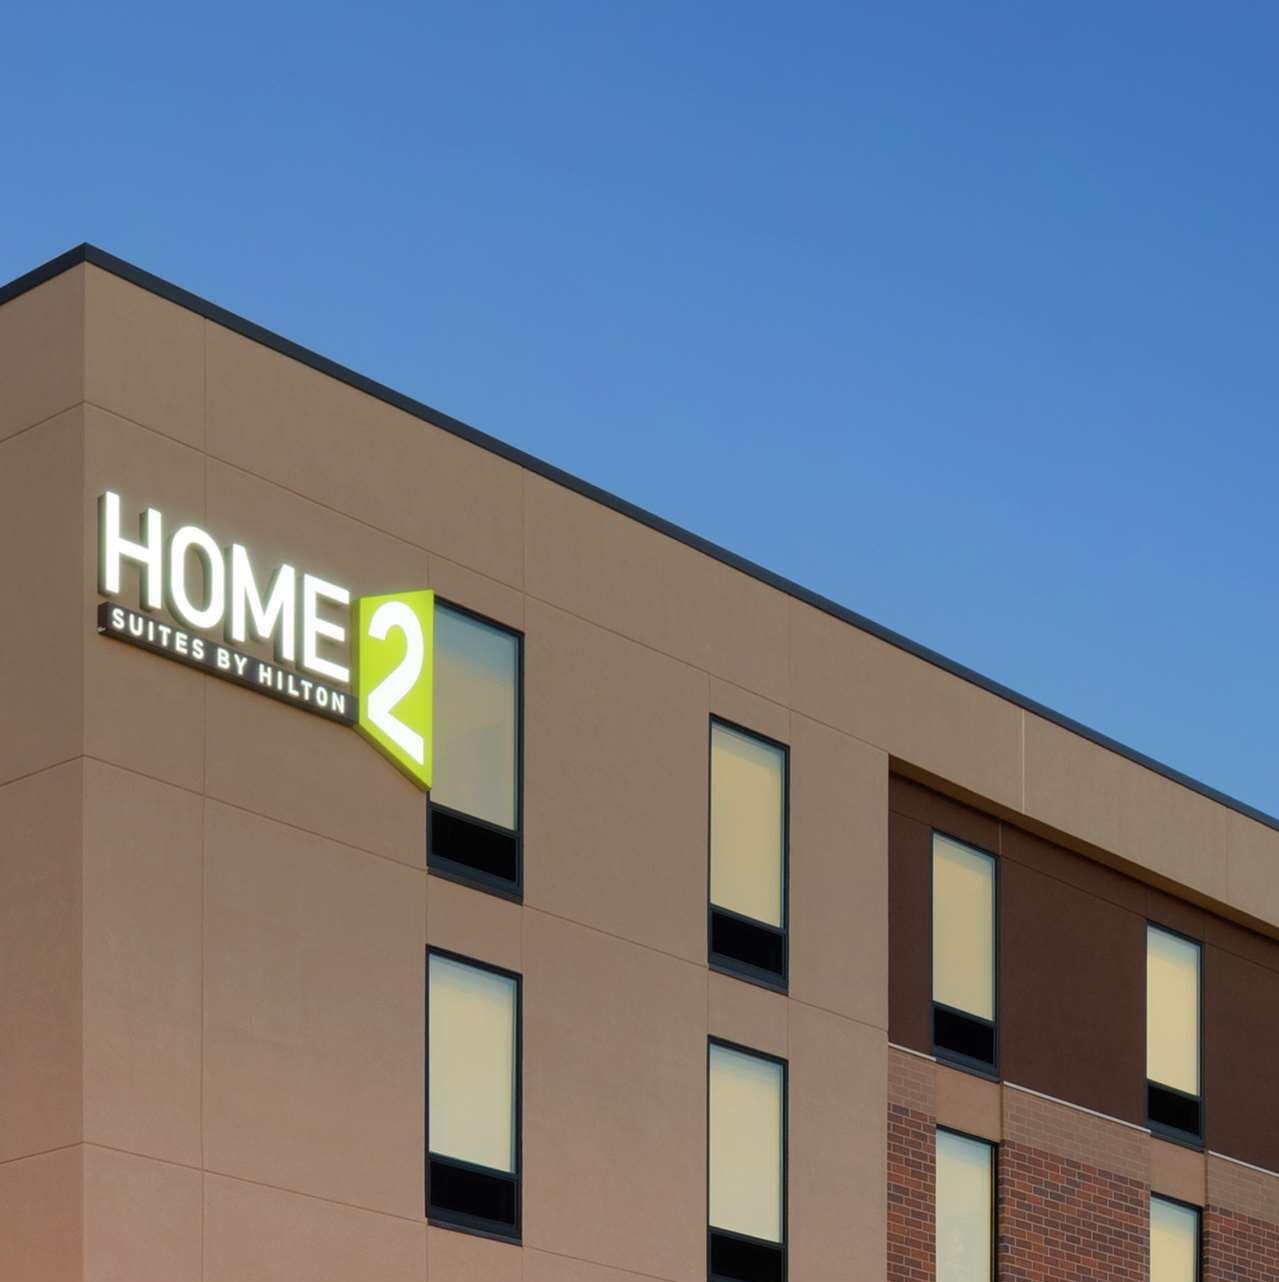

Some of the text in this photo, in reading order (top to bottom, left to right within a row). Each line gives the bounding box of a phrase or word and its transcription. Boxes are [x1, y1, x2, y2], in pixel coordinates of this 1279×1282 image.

[100, 490, 426, 767] HOME 2
[111, 606, 347, 715] SUITES BY HILTON
